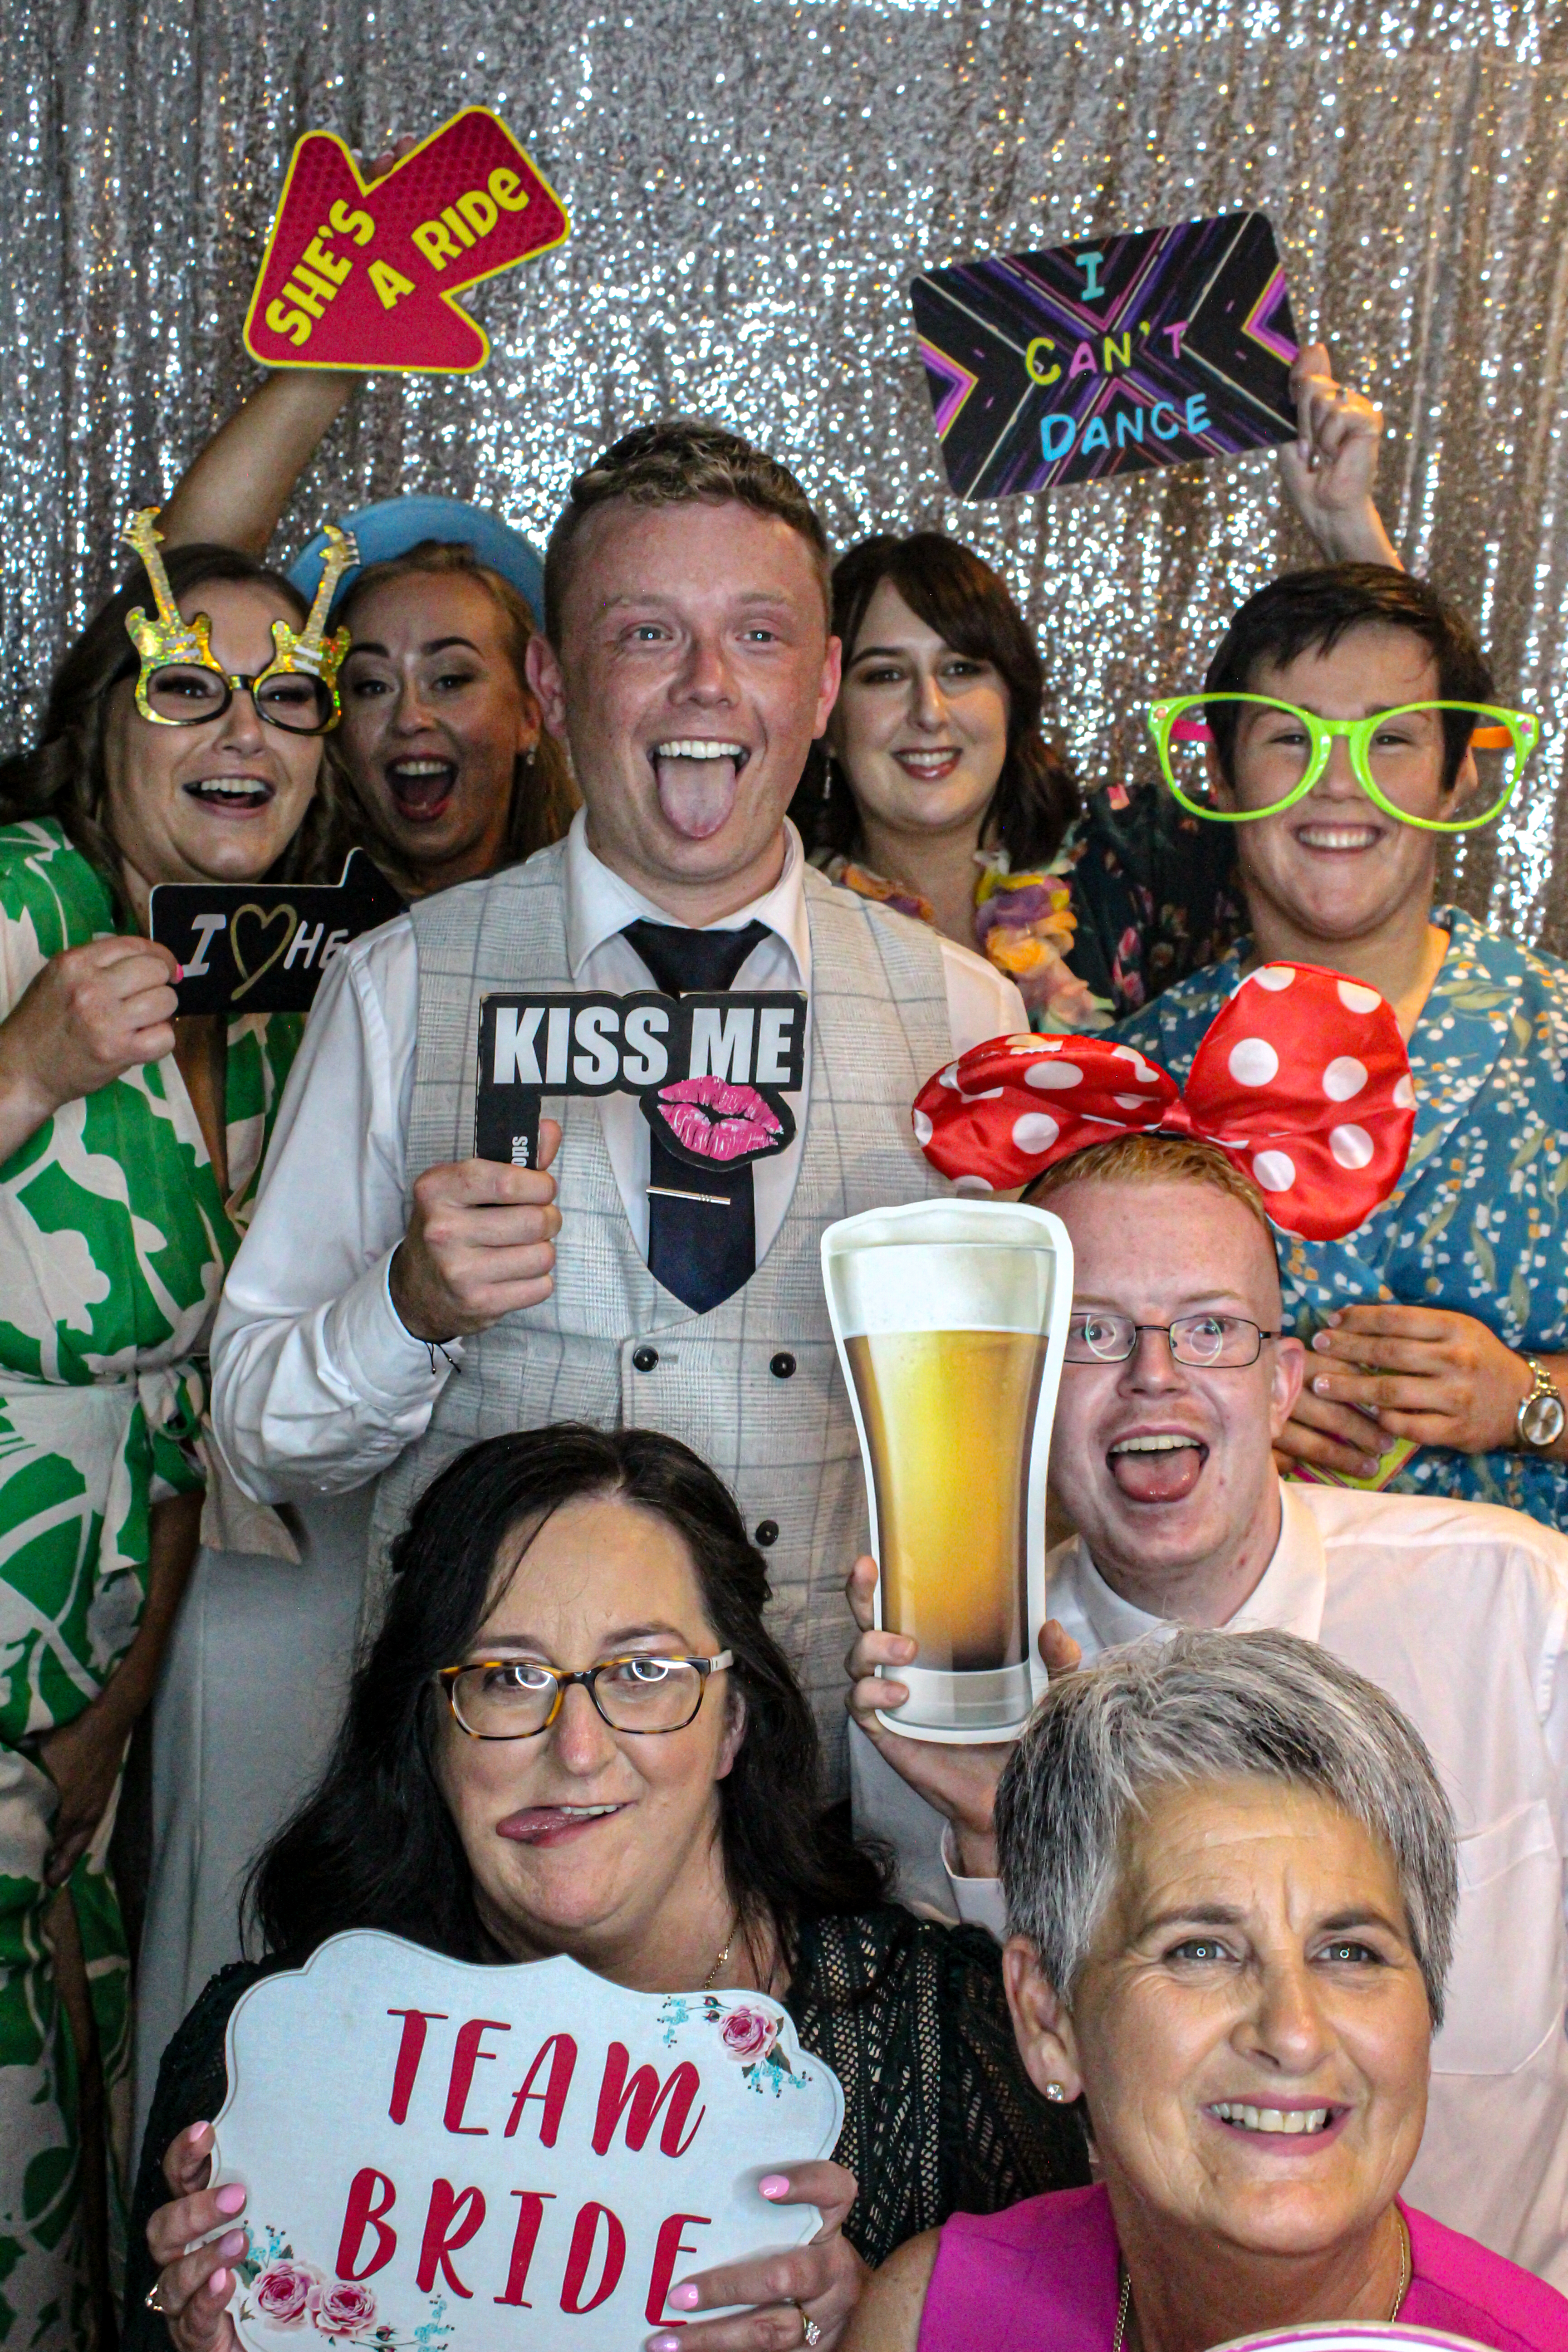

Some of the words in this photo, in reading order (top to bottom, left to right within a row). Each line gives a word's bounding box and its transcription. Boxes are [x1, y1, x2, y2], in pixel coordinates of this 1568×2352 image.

[265, 199, 375, 346] SHE'S
[367, 259, 416, 310] A
[1075, 251, 1106, 301] I
[1025, 320, 1189, 385] CAN'T
[1040, 392, 1211, 462] DANCE
[181, 913, 227, 978] I
[493, 1006, 670, 1085] KISS
[688, 1008, 794, 1083] ME
[386, 2008, 706, 2159] TEAM
[334, 2167, 712, 2328] BRIDE
